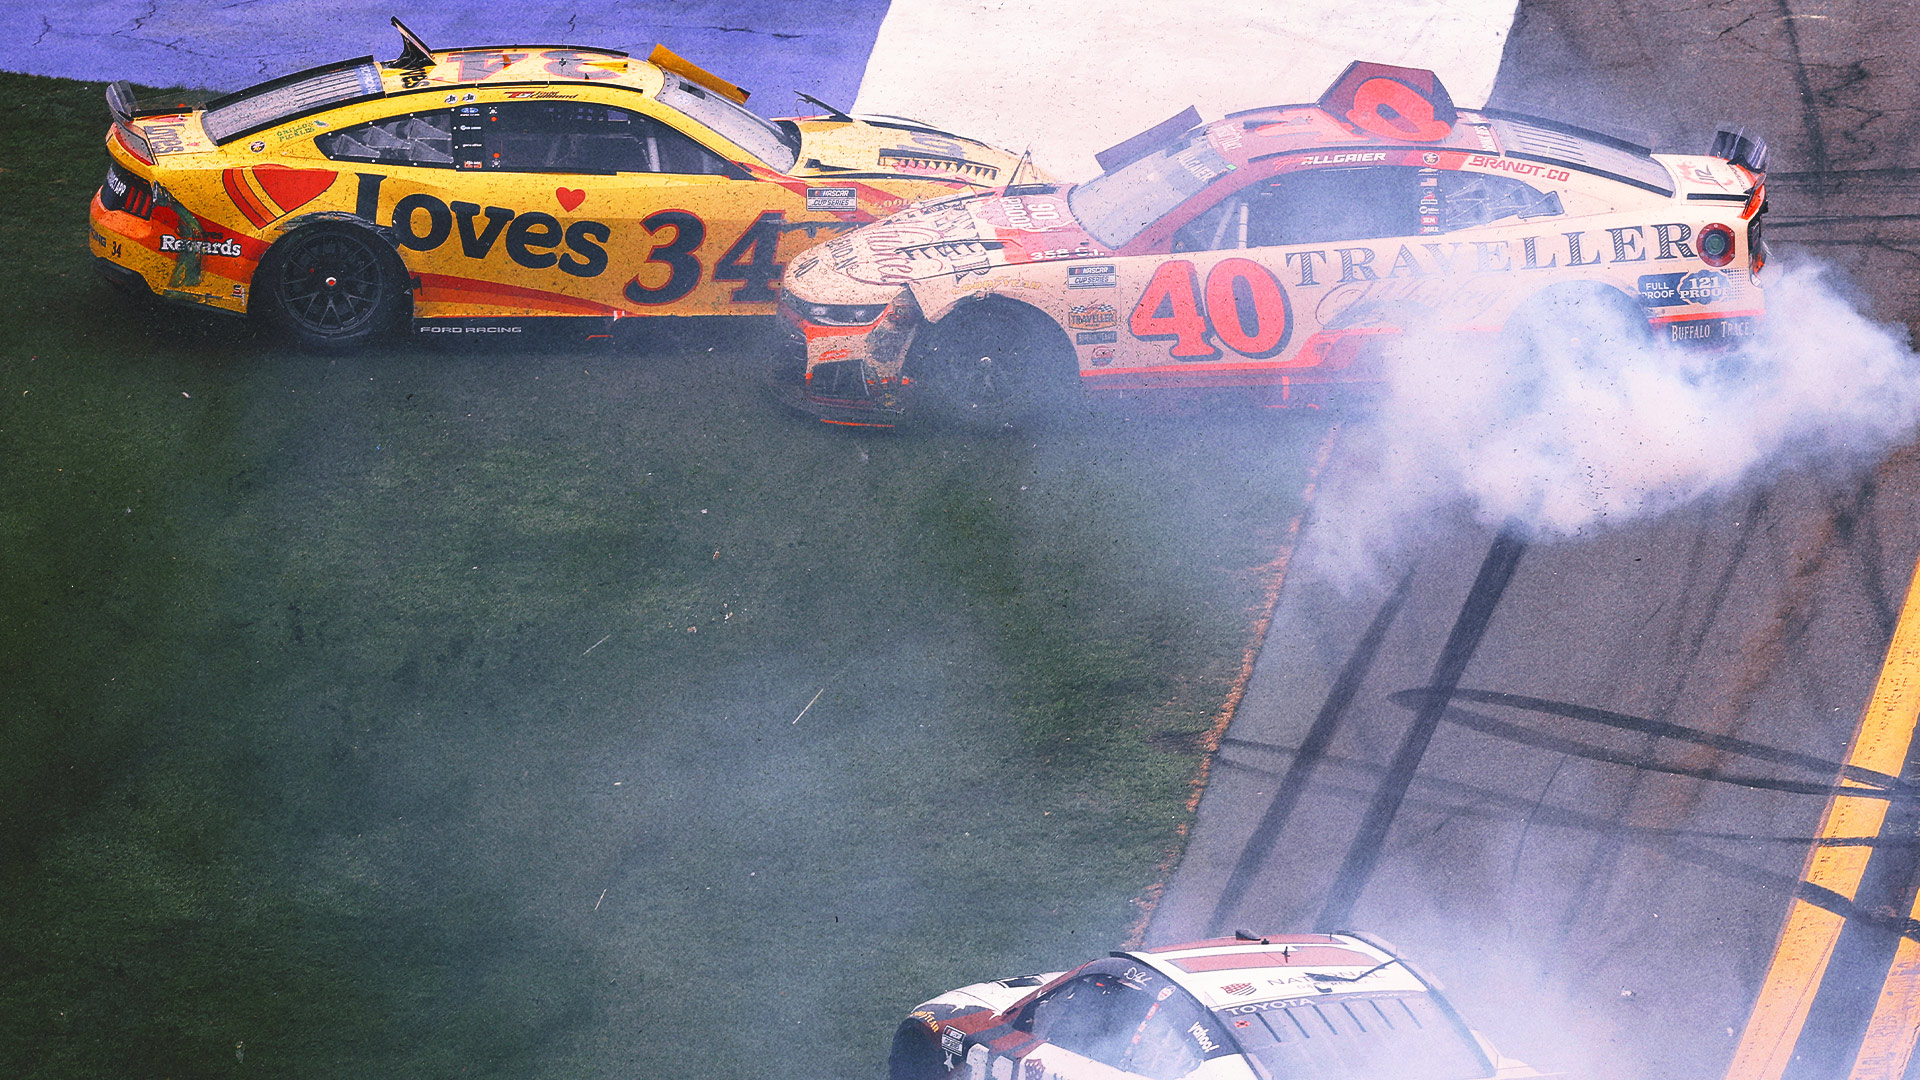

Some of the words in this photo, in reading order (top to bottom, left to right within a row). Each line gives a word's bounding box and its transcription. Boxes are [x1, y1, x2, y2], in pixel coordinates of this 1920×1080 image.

[1301, 152, 1387, 166] ALLGAIER
[1468, 155, 1570, 182] BRANDT.CO
[160, 234, 243, 258] Rewards
[623, 208, 788, 306] 34
[1286, 223, 1698, 288] TRAVELLER
[1645, 282, 1670, 291] FULL
[1690, 276, 1719, 289] 121
[1128, 257, 1293, 362] 40
[1671, 324, 1711, 342] BUFFALO
[1720, 321, 1750, 338] TRACE
[1226, 998, 1316, 1017] TOYOTA
